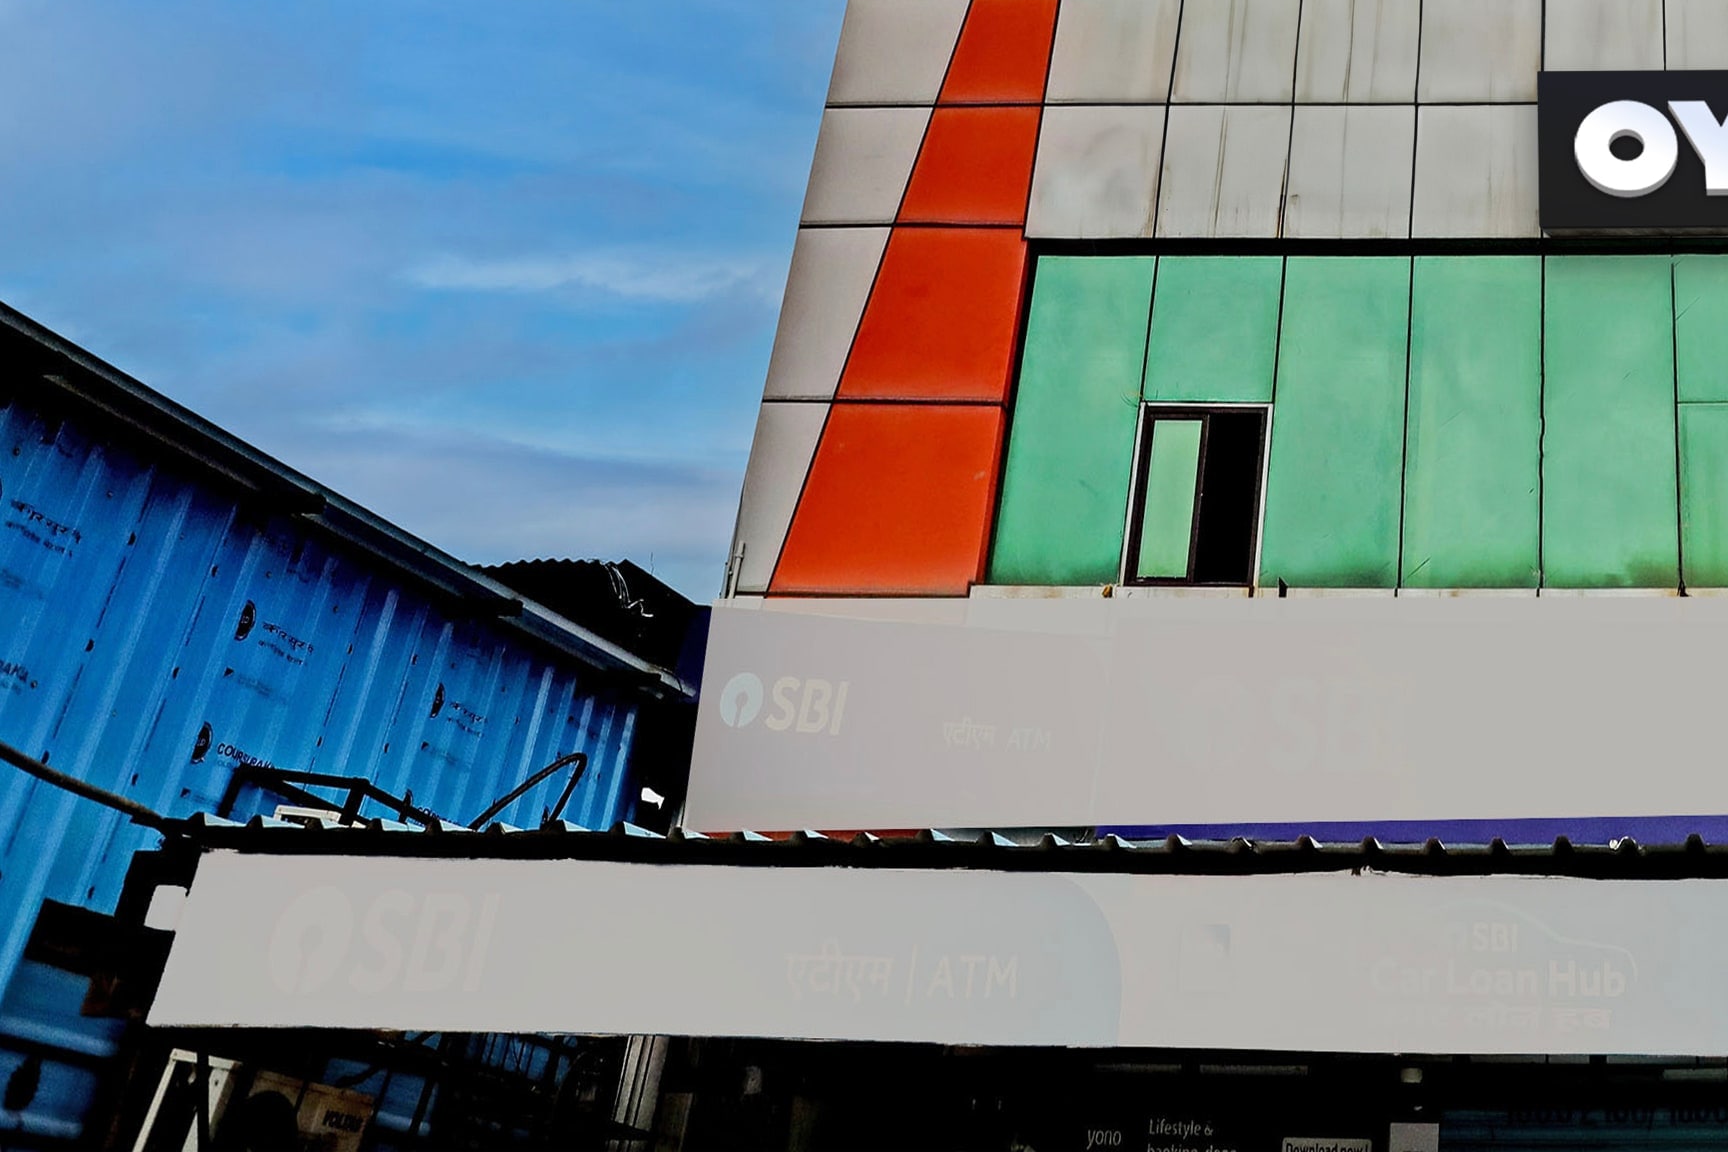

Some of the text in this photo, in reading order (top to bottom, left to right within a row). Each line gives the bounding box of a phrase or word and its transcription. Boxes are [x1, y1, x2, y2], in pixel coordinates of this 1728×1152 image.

[764, 676, 851, 736] SBI
[1086, 1129, 1122, 1151] yono
[1149, 1118, 1202, 1140] Lifestyle
